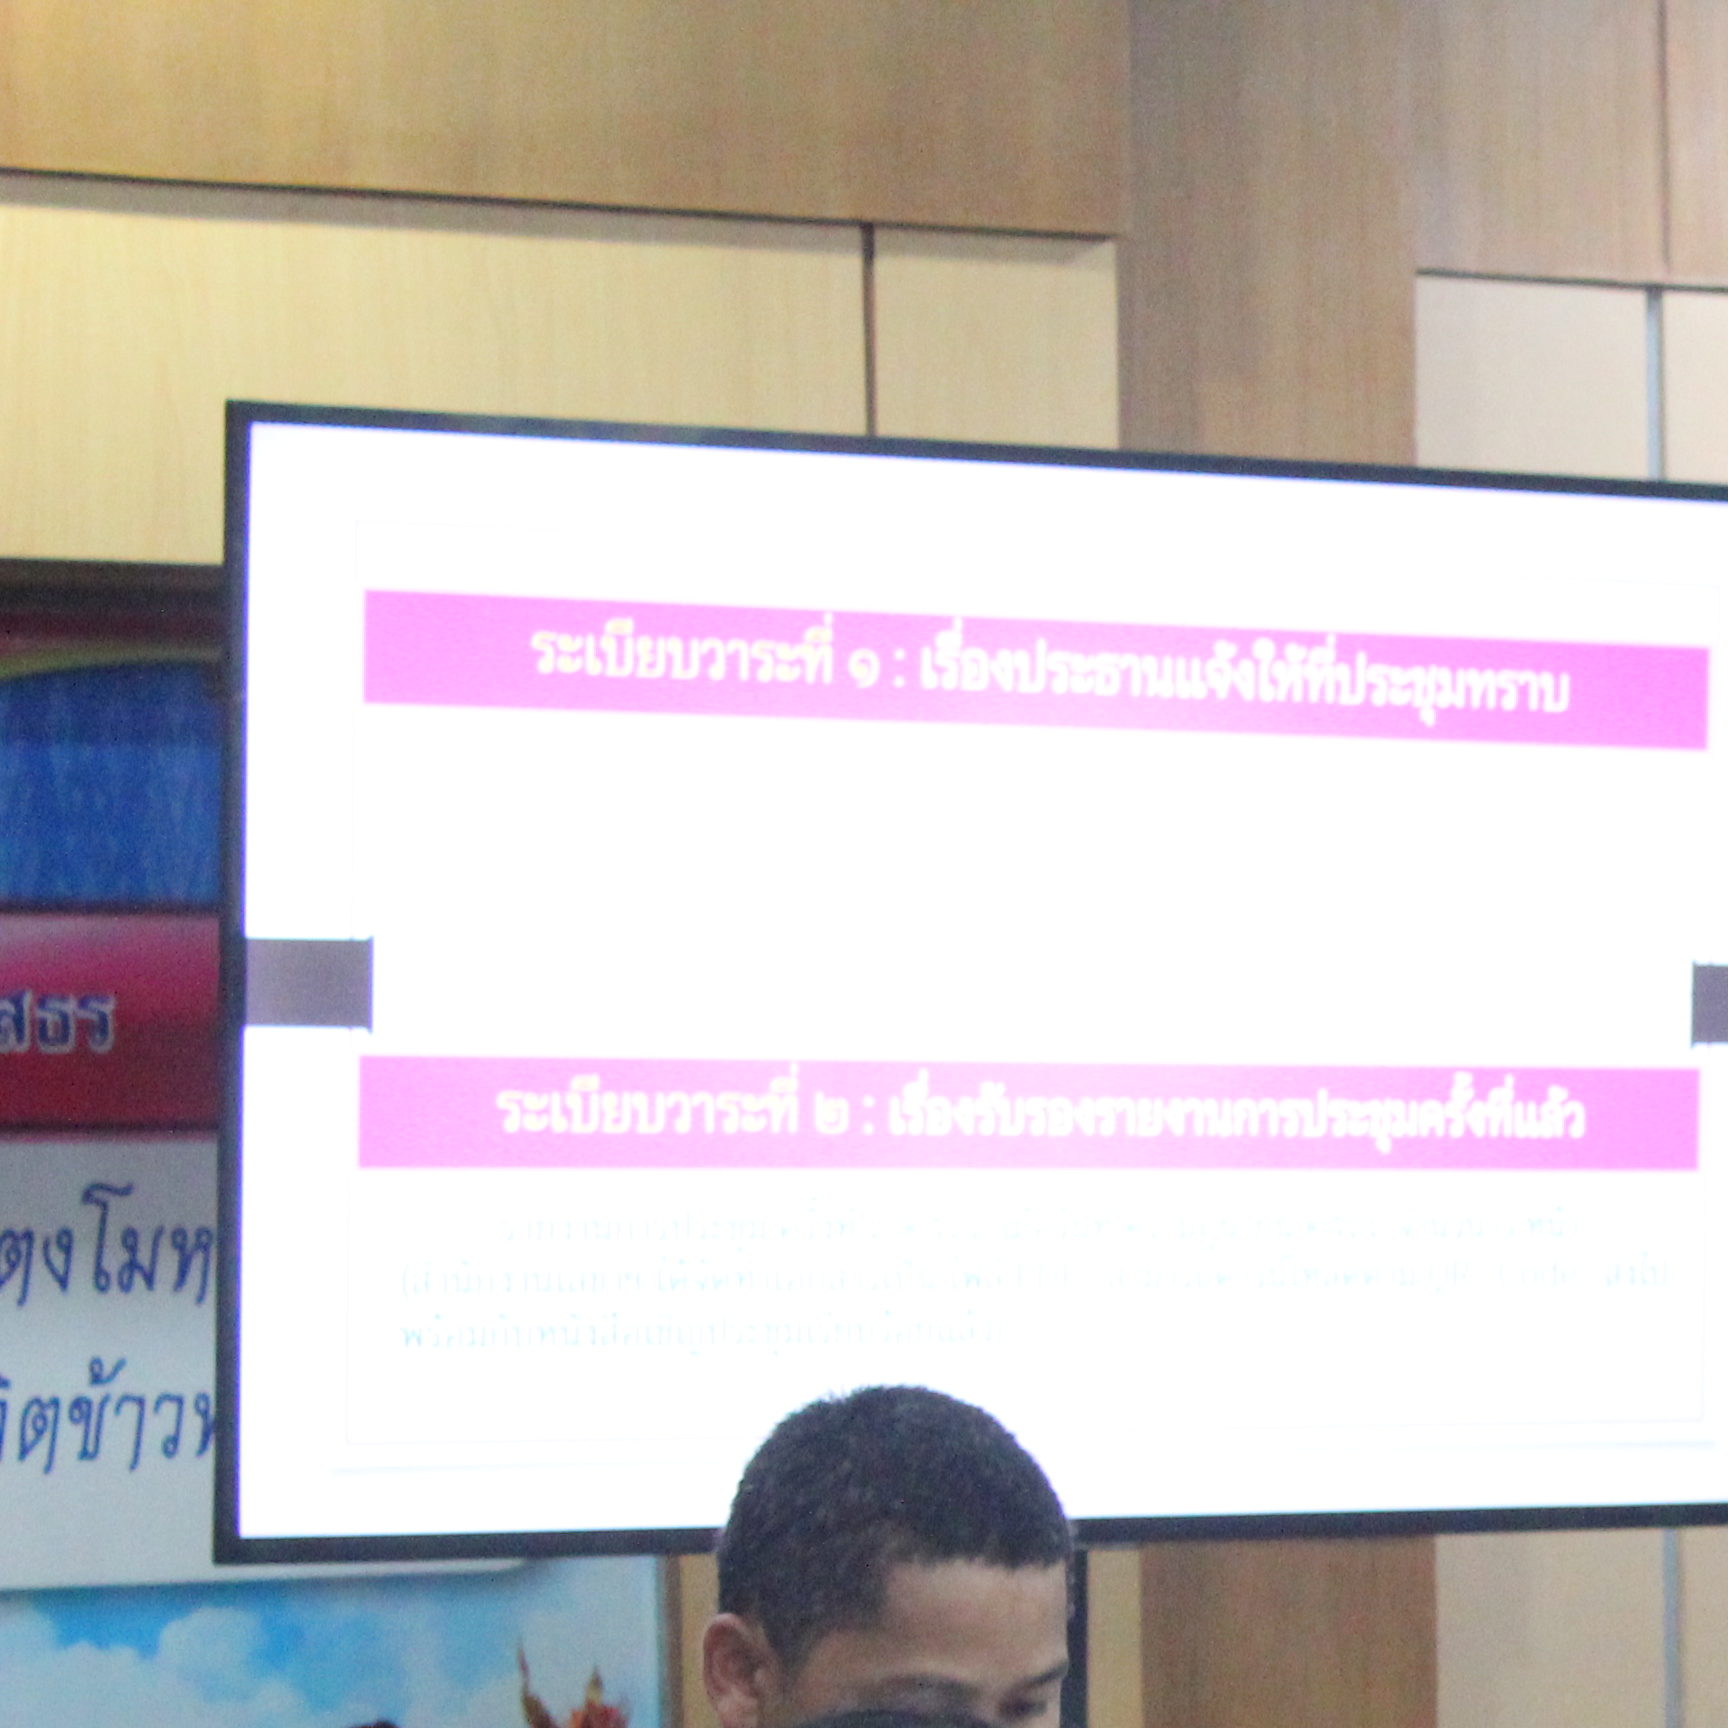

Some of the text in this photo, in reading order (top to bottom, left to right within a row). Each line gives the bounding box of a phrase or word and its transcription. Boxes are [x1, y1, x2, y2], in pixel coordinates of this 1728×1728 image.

[531, 611, 834, 686] ระเบียบวาระที่
[497, 1060, 800, 1136] ระเบียบวาระที่
